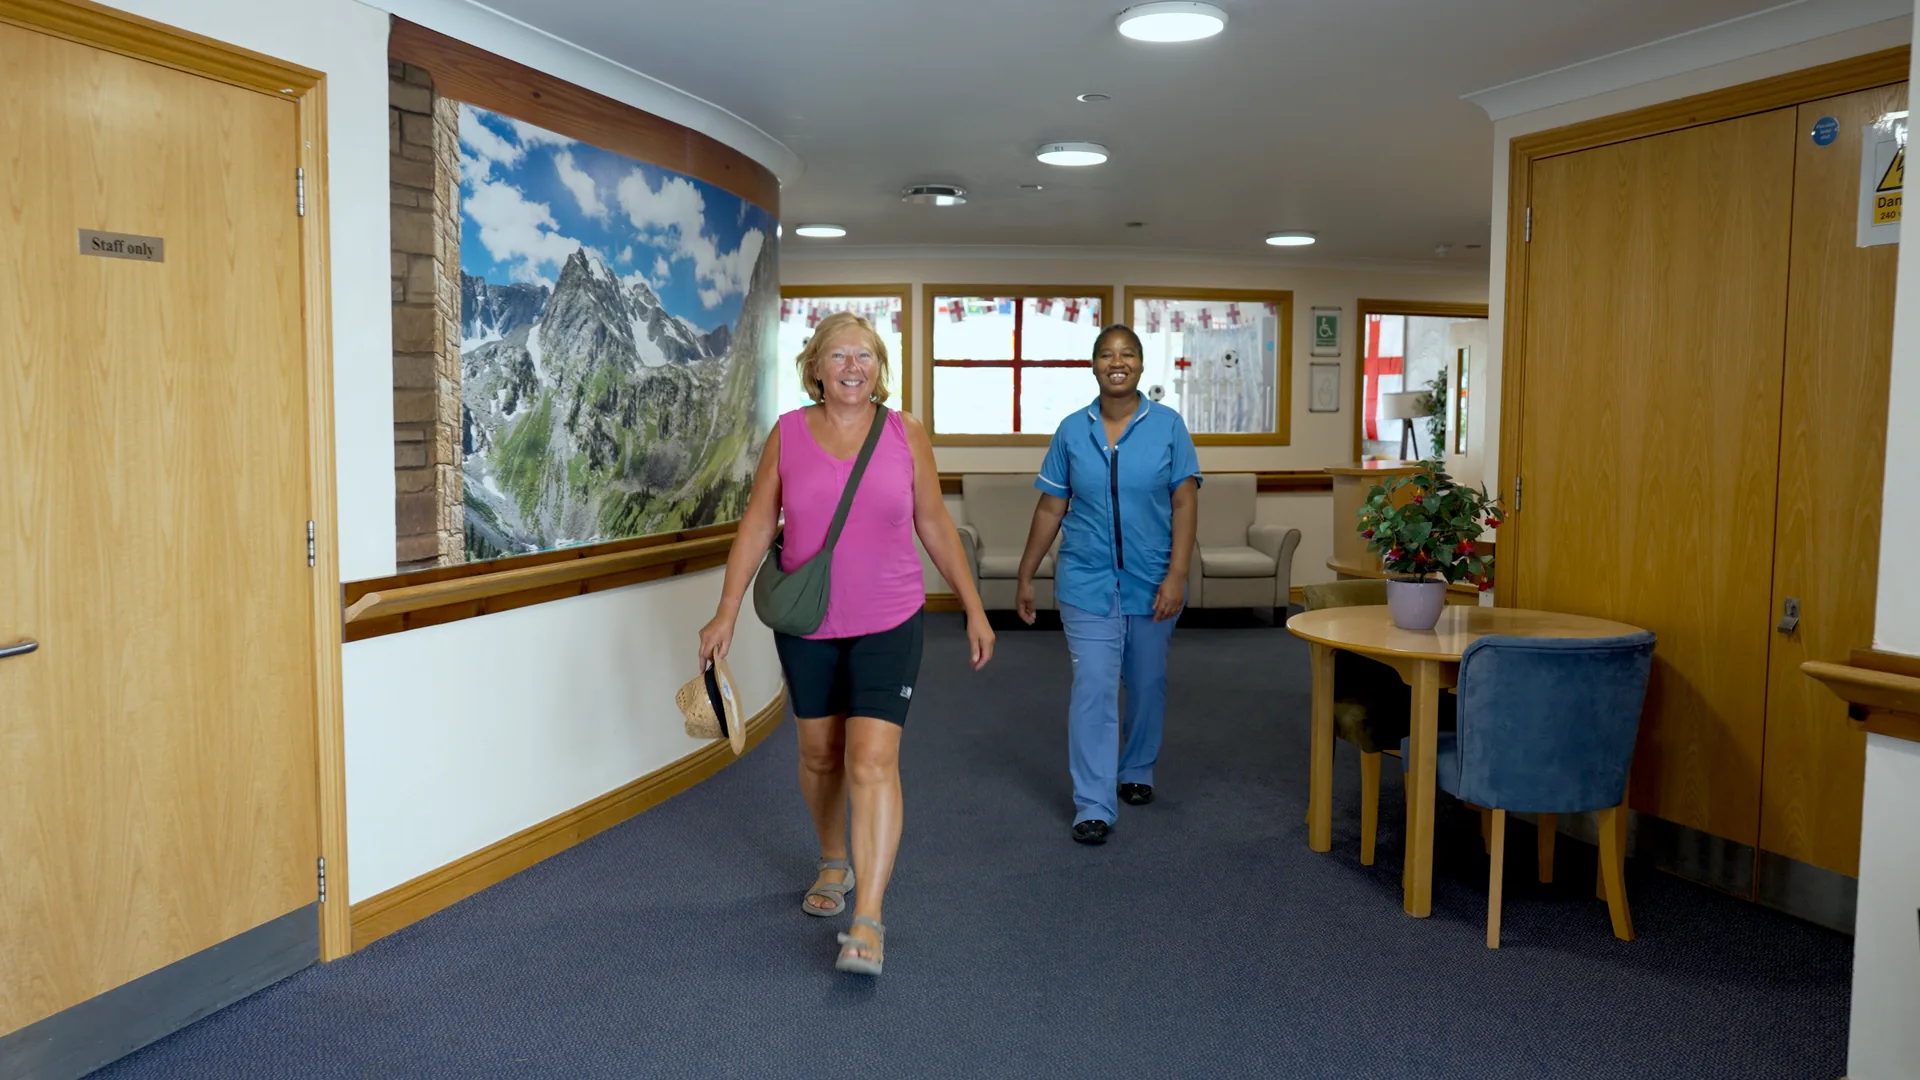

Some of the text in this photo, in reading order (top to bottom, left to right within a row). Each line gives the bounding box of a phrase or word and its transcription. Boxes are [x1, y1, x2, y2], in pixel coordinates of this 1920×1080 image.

[1880, 211, 1896, 220] 240
[91, 236, 154, 259] Staff only
